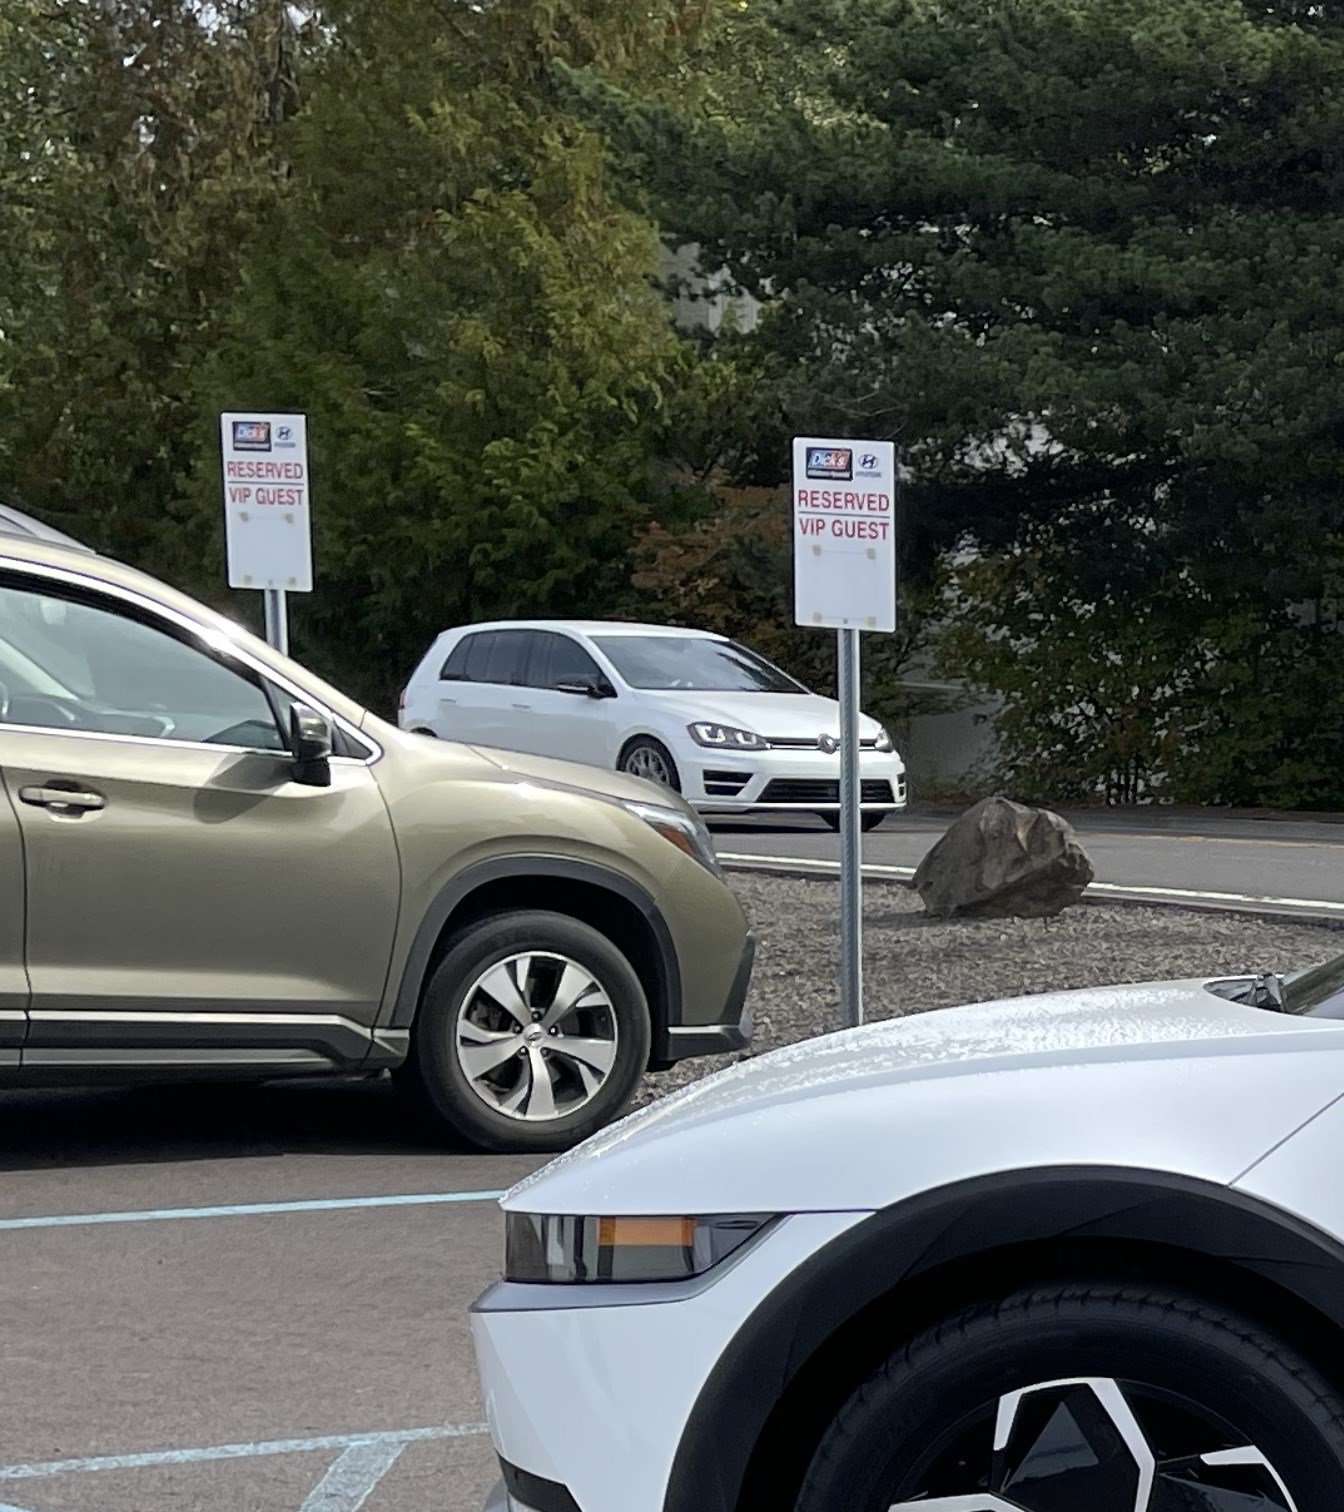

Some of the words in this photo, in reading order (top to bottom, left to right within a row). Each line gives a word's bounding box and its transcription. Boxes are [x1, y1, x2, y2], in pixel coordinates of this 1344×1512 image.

[227, 461, 303, 479] RESERVED
[228, 487, 251, 503] VIP
[255, 488, 304, 506] GUEST
[798, 489, 890, 512] RESERVED
[799, 518, 825, 535] VIP
[832, 520, 890, 540] GUEST
